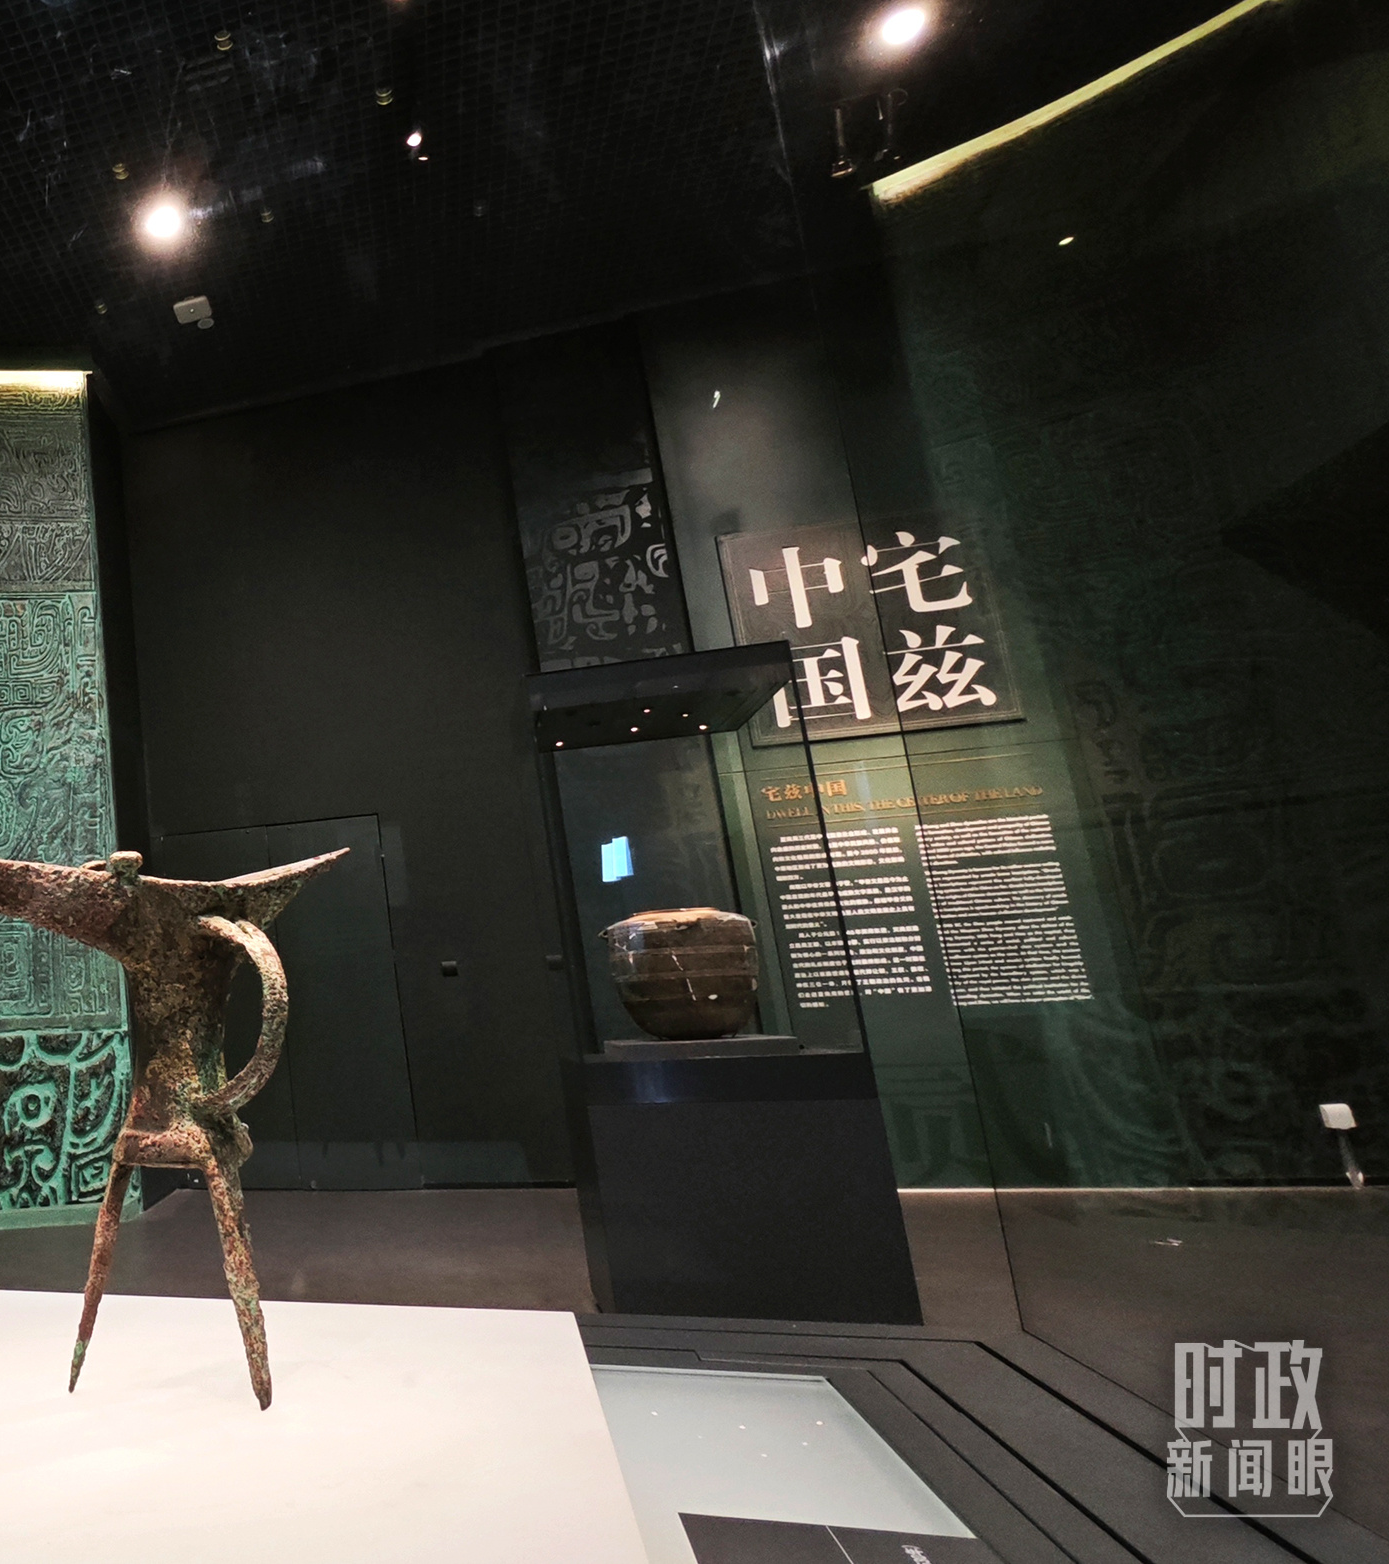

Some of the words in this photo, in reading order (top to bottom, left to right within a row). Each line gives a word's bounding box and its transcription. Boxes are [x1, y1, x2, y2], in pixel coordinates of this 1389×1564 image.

[861, 531, 998, 713] 宅兹
[761, 779, 848, 803] 宅兹中国
[766, 806, 811, 821] DWELL
[868, 799, 896, 812] THE
[950, 792, 970, 804] OF
[975, 788, 1002, 801] THE
[1003, 784, 1043, 799] LAND
